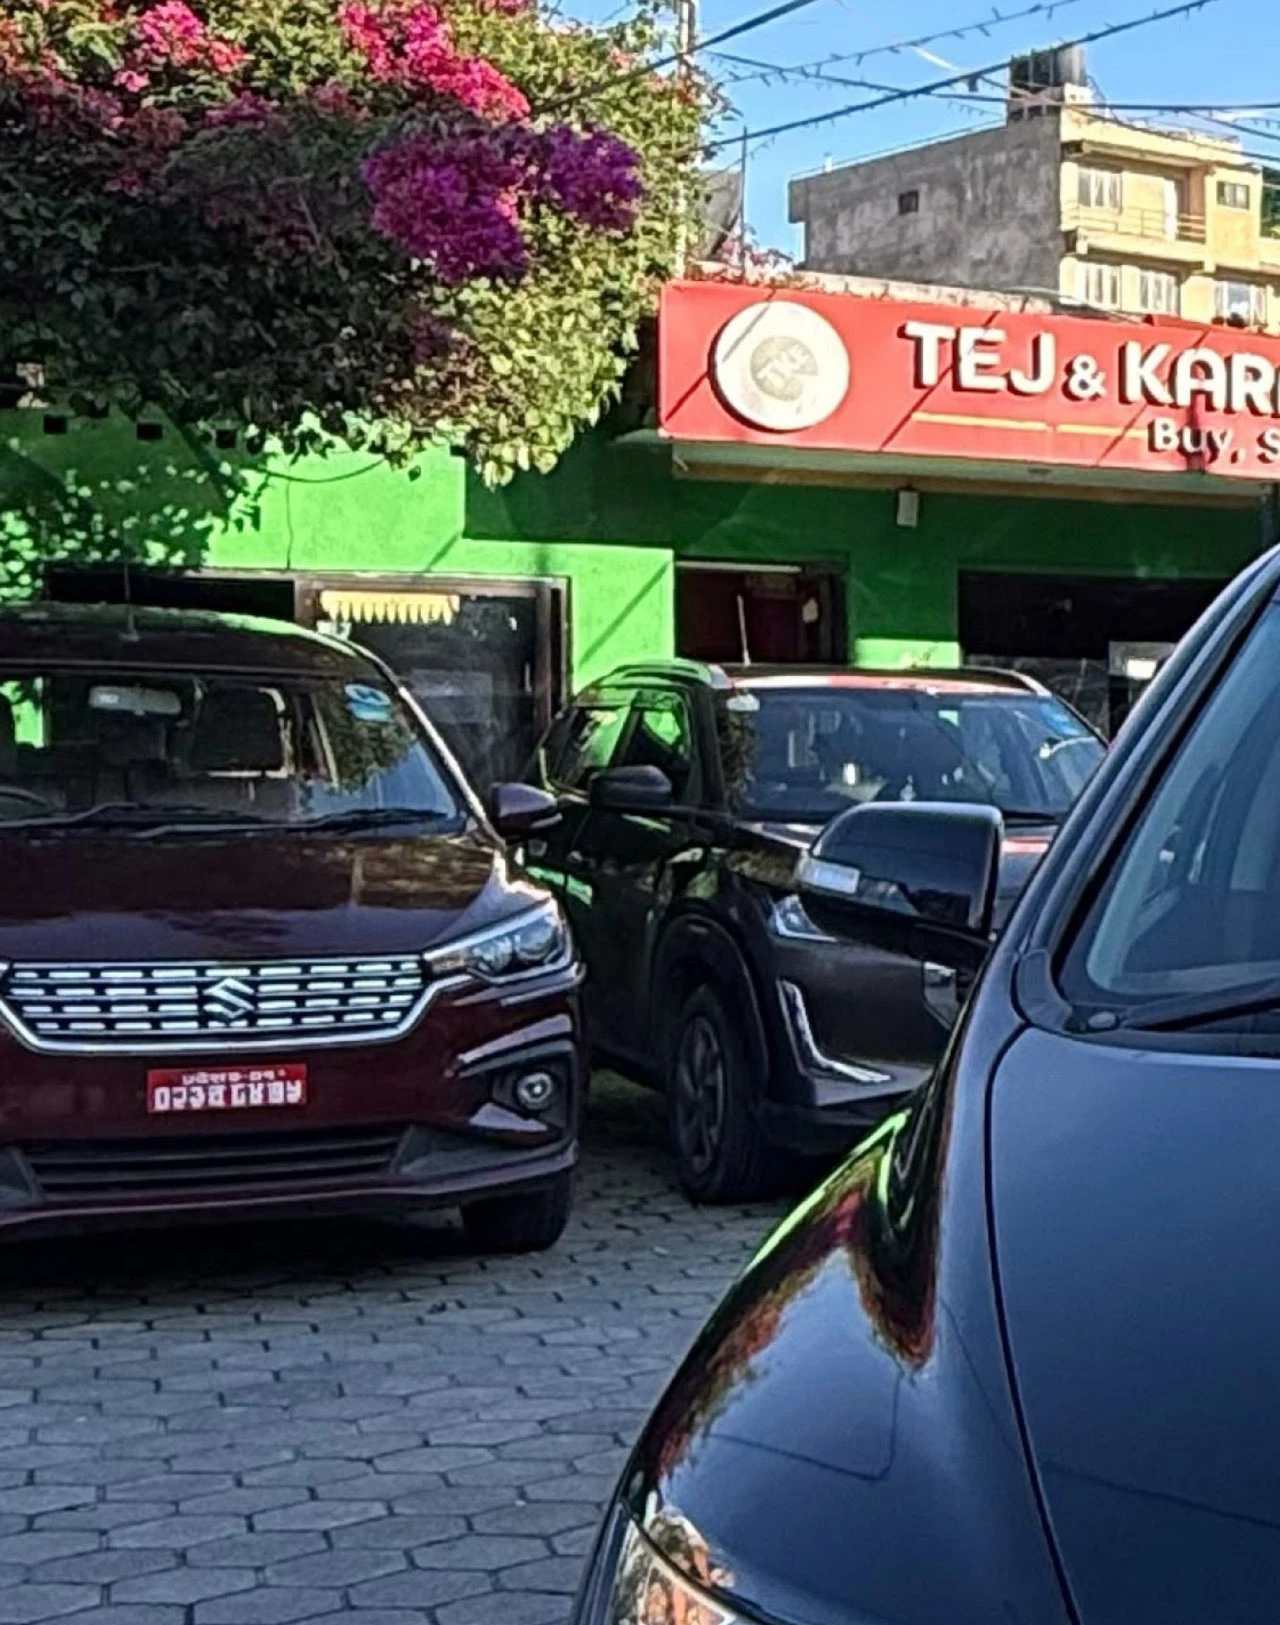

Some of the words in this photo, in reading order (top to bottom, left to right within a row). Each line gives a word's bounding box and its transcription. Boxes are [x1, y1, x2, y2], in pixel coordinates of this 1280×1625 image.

[901, 320, 1056, 396] TEJ
[1065, 354, 1107, 400] &
[1151, 416, 1248, 462] Buy,
